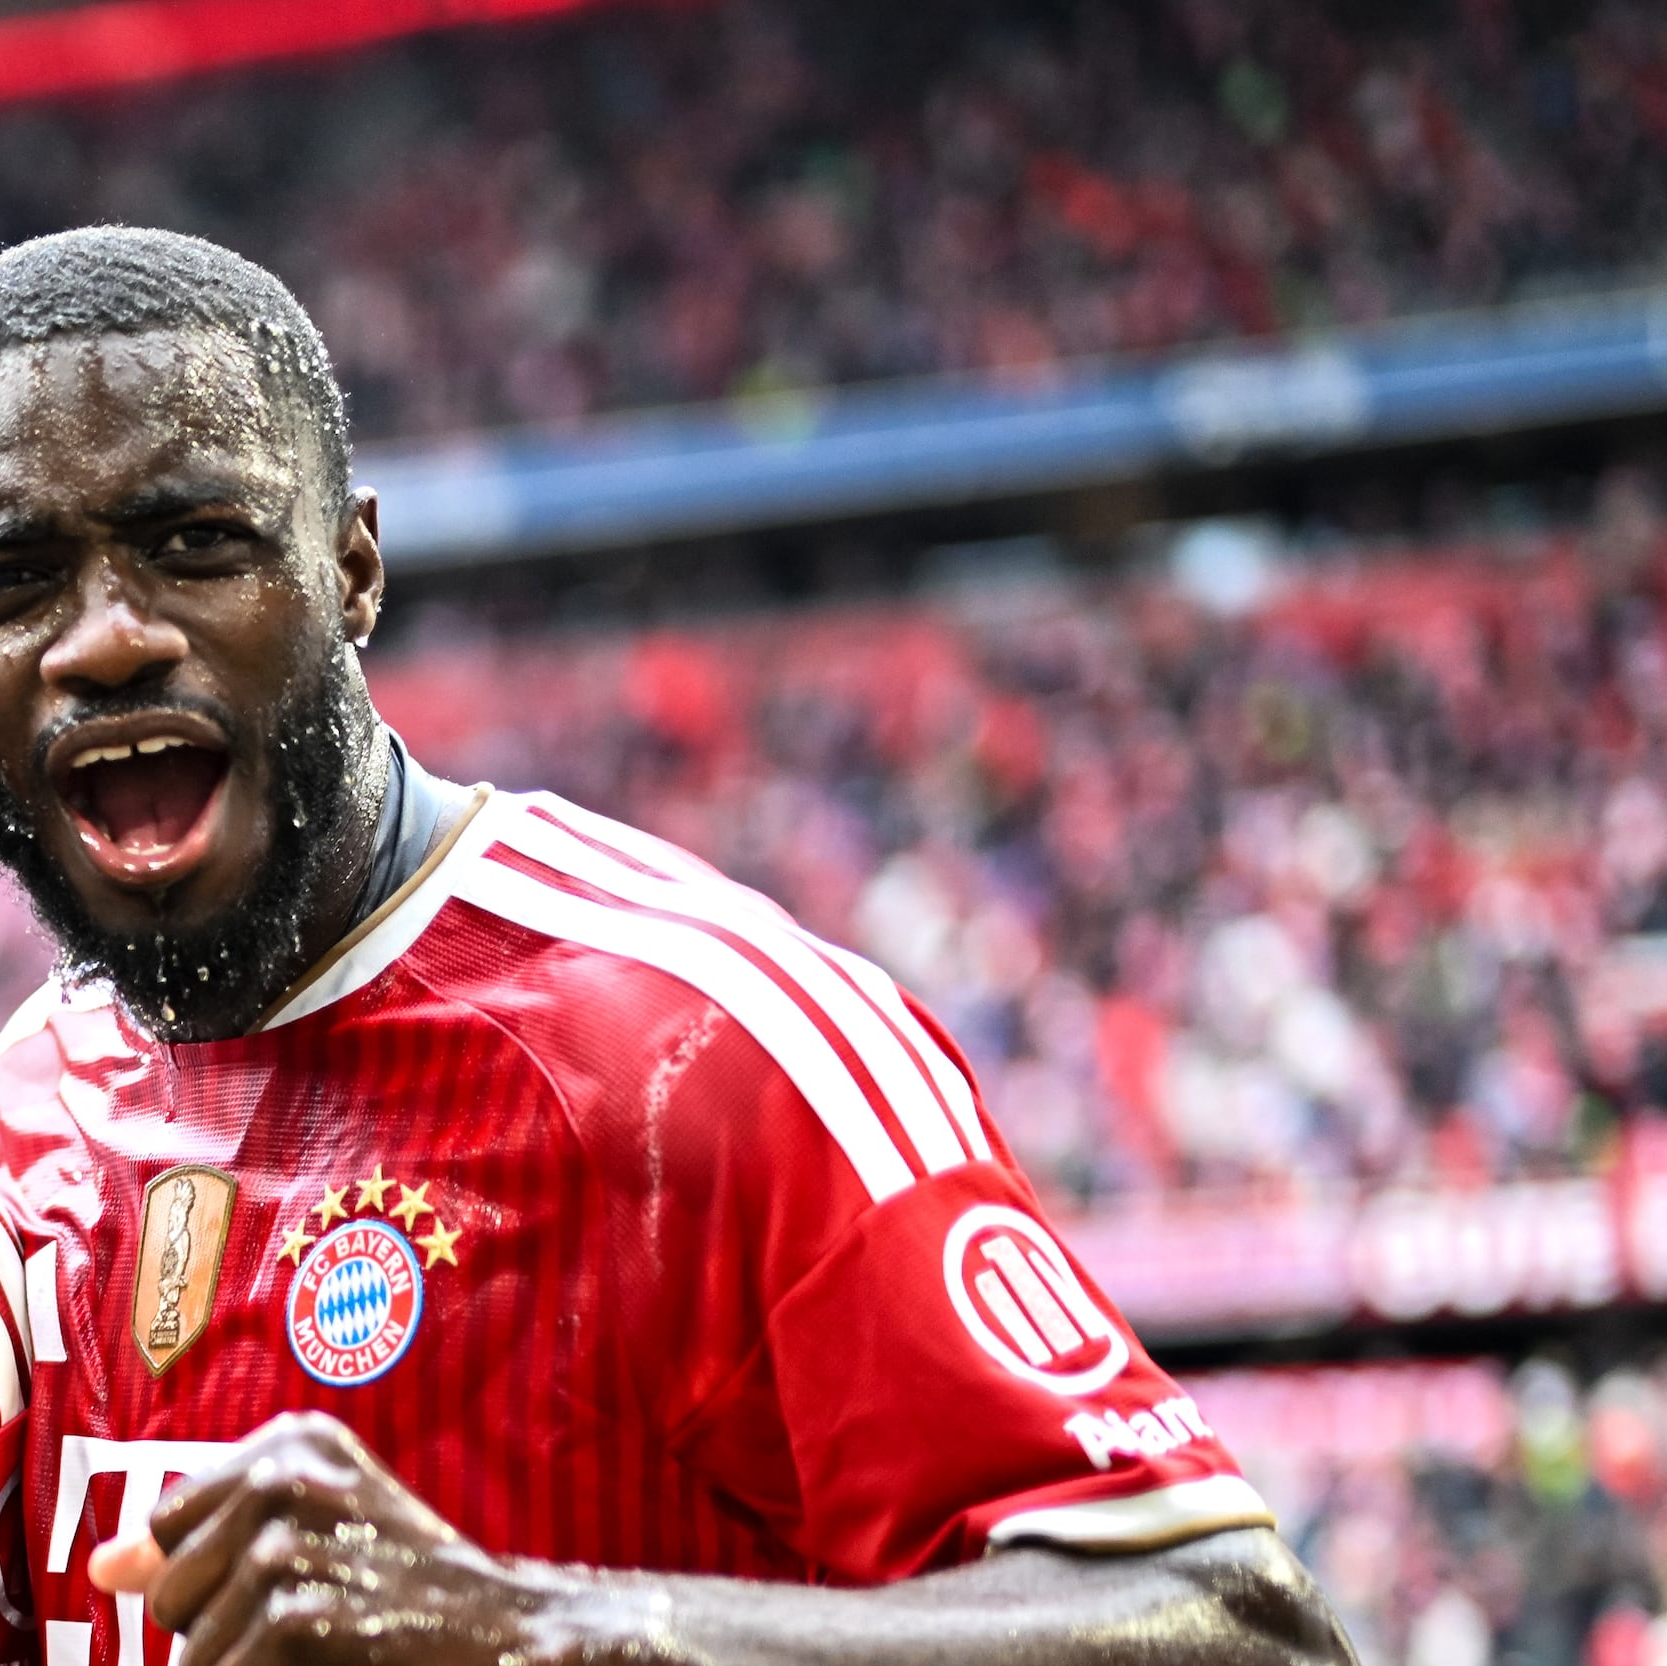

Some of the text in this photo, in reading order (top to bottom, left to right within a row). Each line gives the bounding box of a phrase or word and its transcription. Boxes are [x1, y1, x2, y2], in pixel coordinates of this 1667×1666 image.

[303, 1232, 411, 1295] FC BAYERN
[295, 1316, 405, 1375] MÜNCHEN
